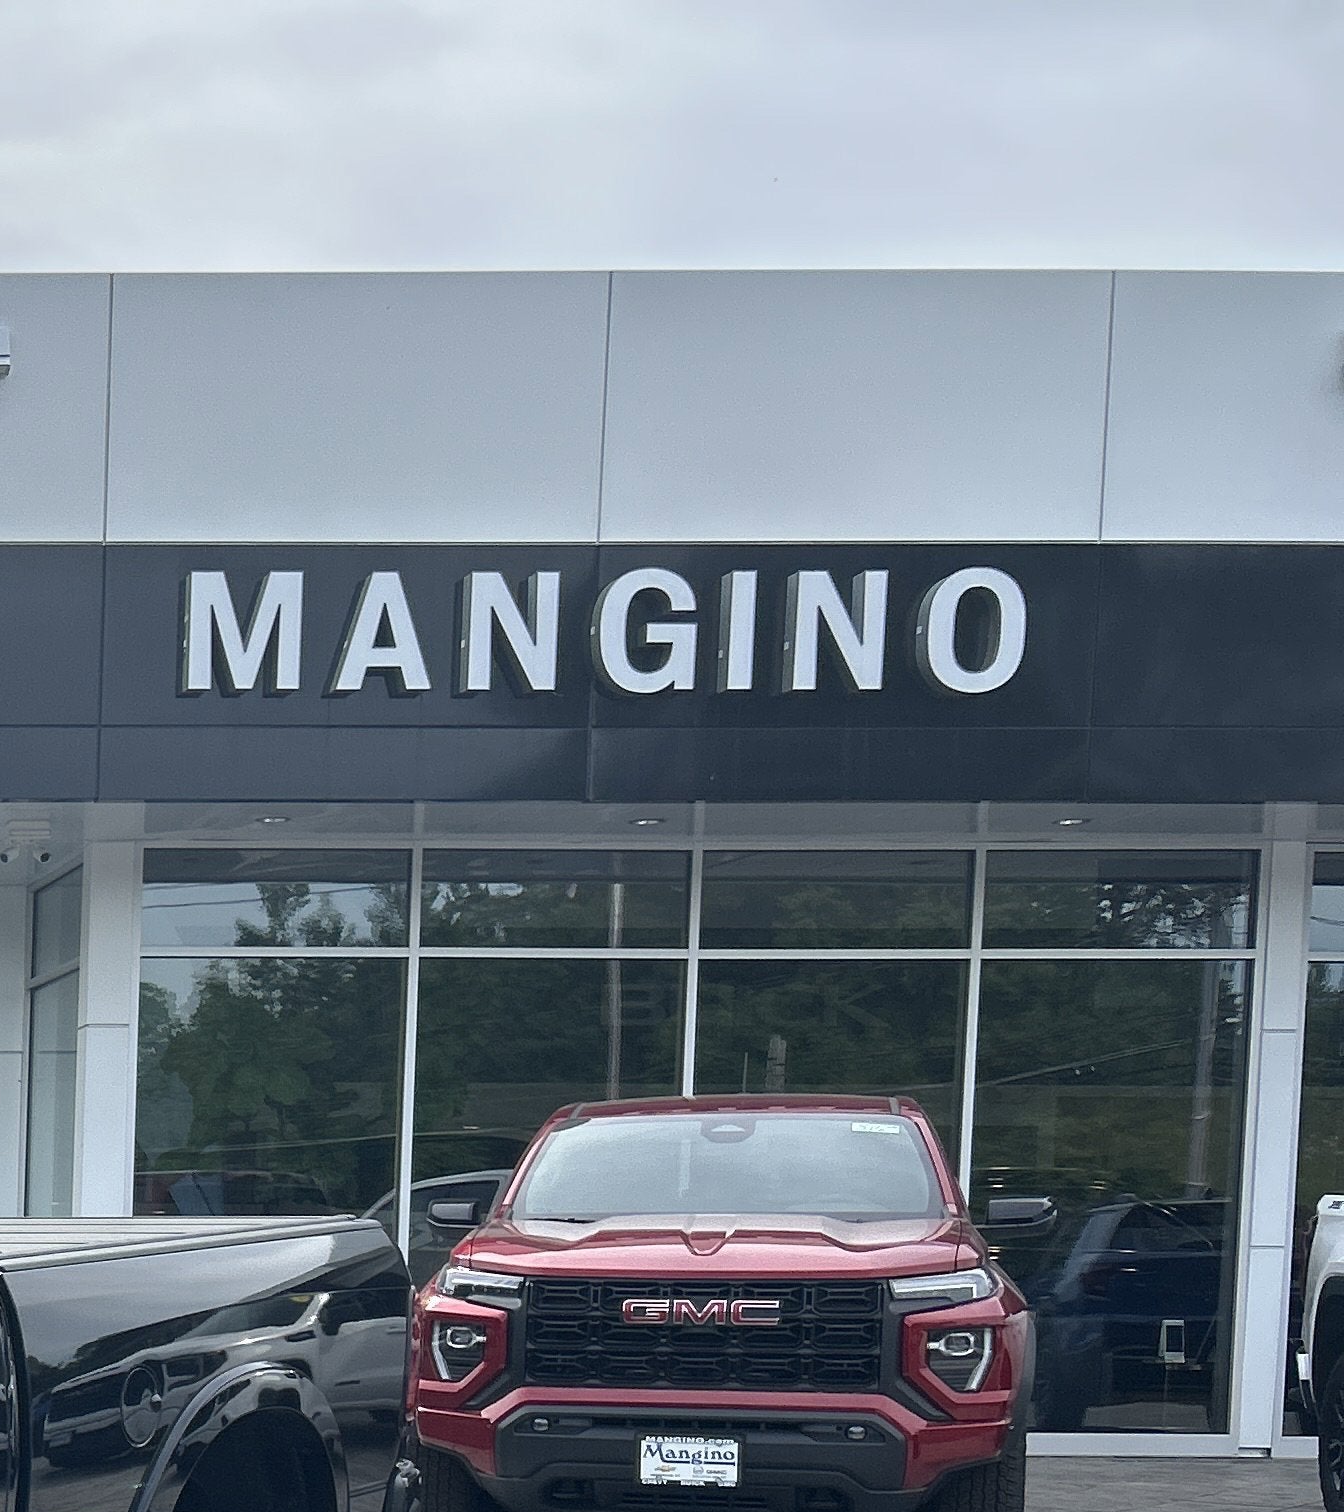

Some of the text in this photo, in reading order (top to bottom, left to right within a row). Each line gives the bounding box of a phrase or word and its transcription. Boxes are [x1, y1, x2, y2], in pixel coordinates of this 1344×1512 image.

[182, 566, 1028, 694] MANGINO
[622, 1299, 780, 1325] GMC
[642, 1442, 736, 1466] Mangino
